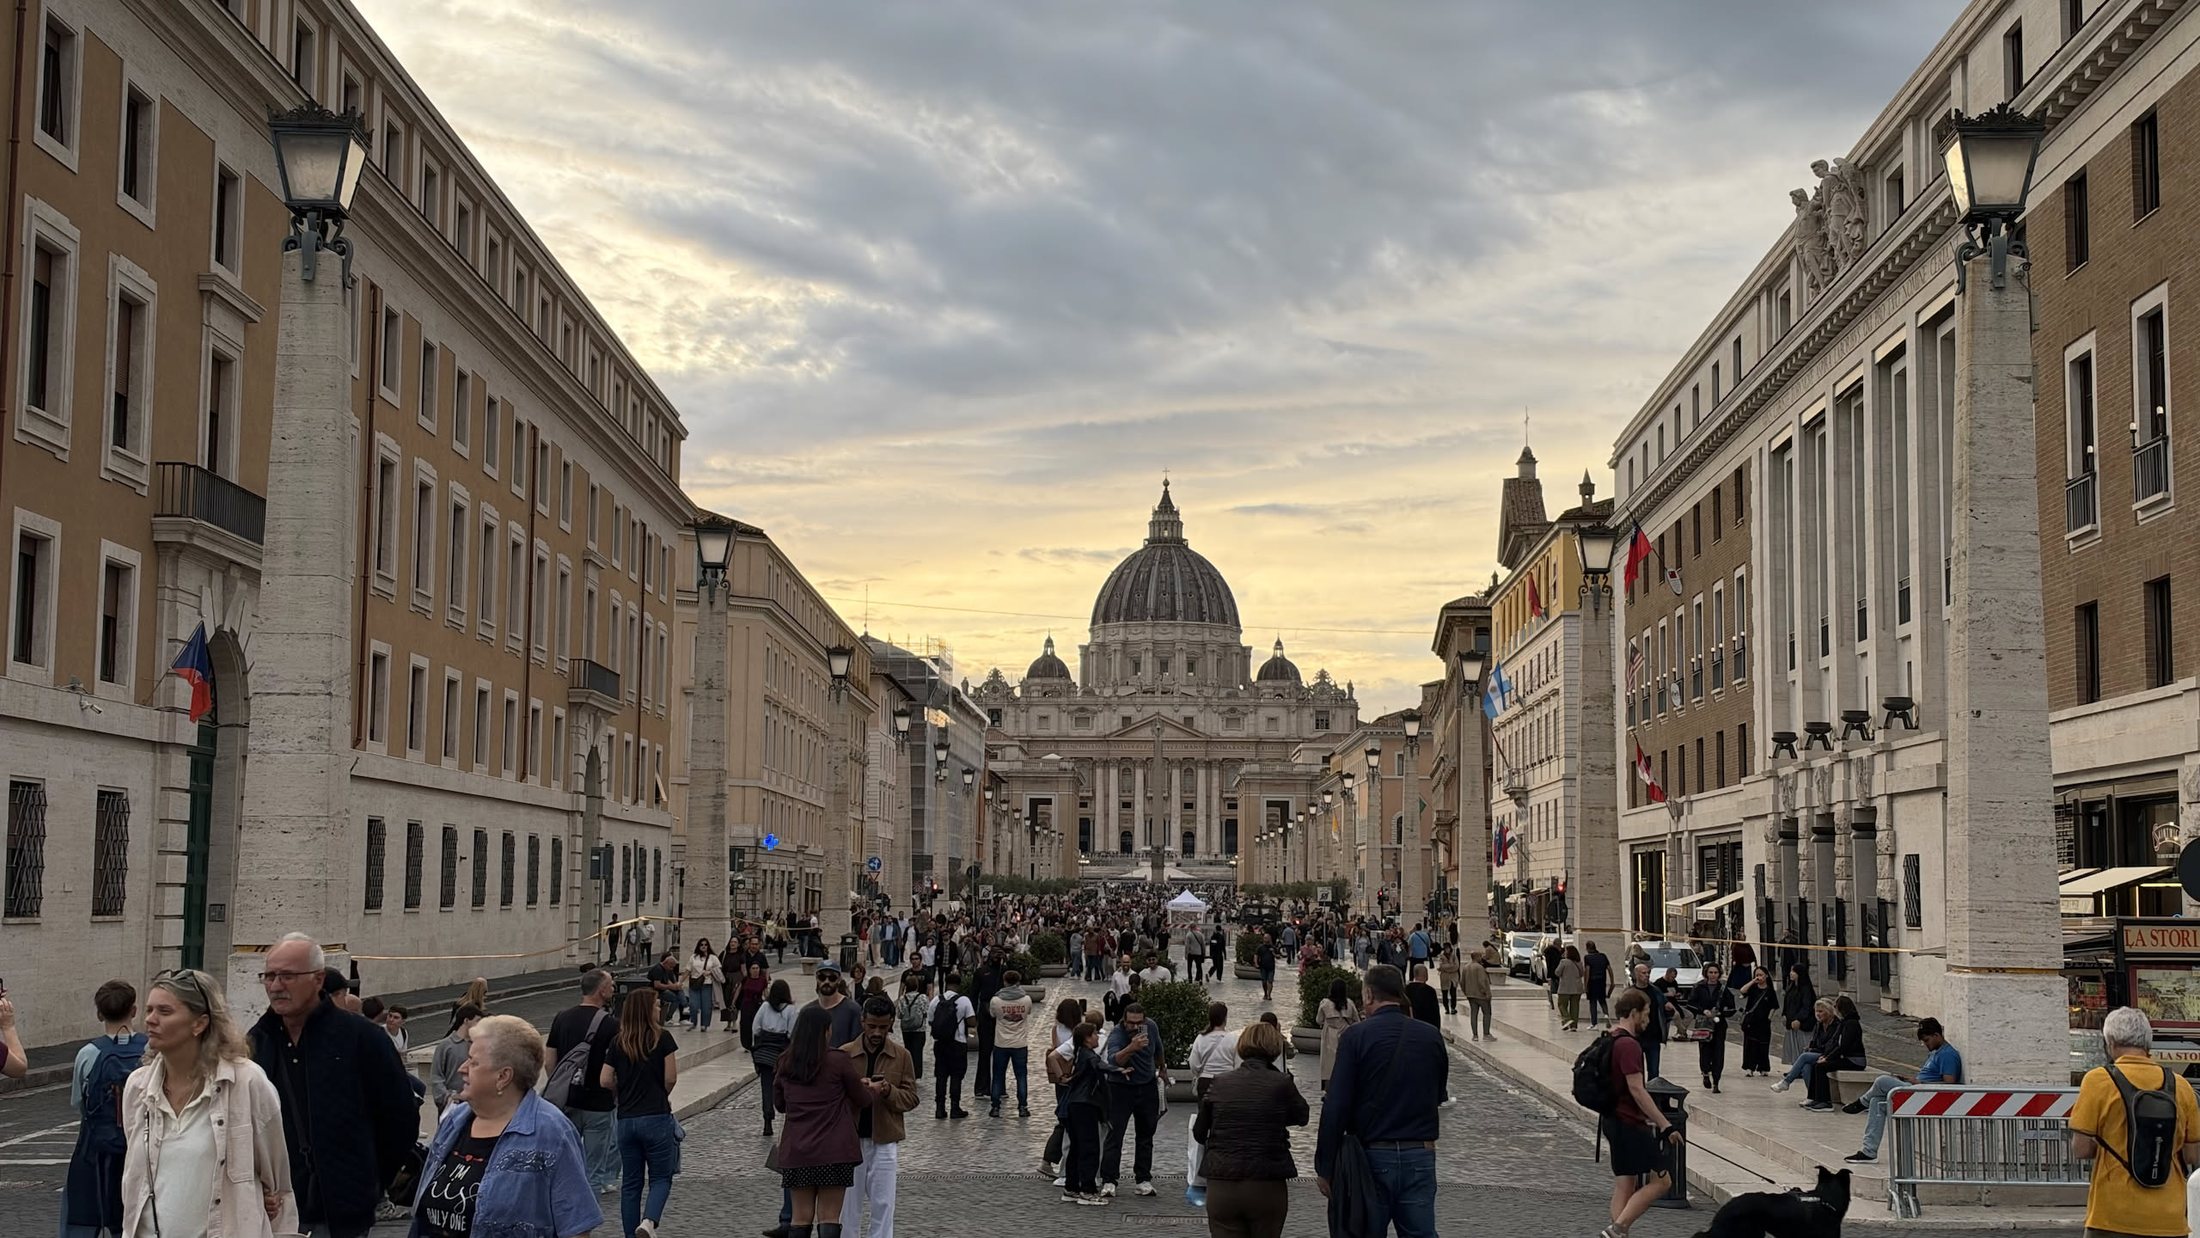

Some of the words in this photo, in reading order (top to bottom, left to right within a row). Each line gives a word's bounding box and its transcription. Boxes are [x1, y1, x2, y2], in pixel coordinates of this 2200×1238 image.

[2125, 929, 2147, 948] LA
[1001, 1005, 1025, 1014] TOKYO
[2176, 1051, 2200, 1061] STO
[450, 1213, 467, 1231] ONE
